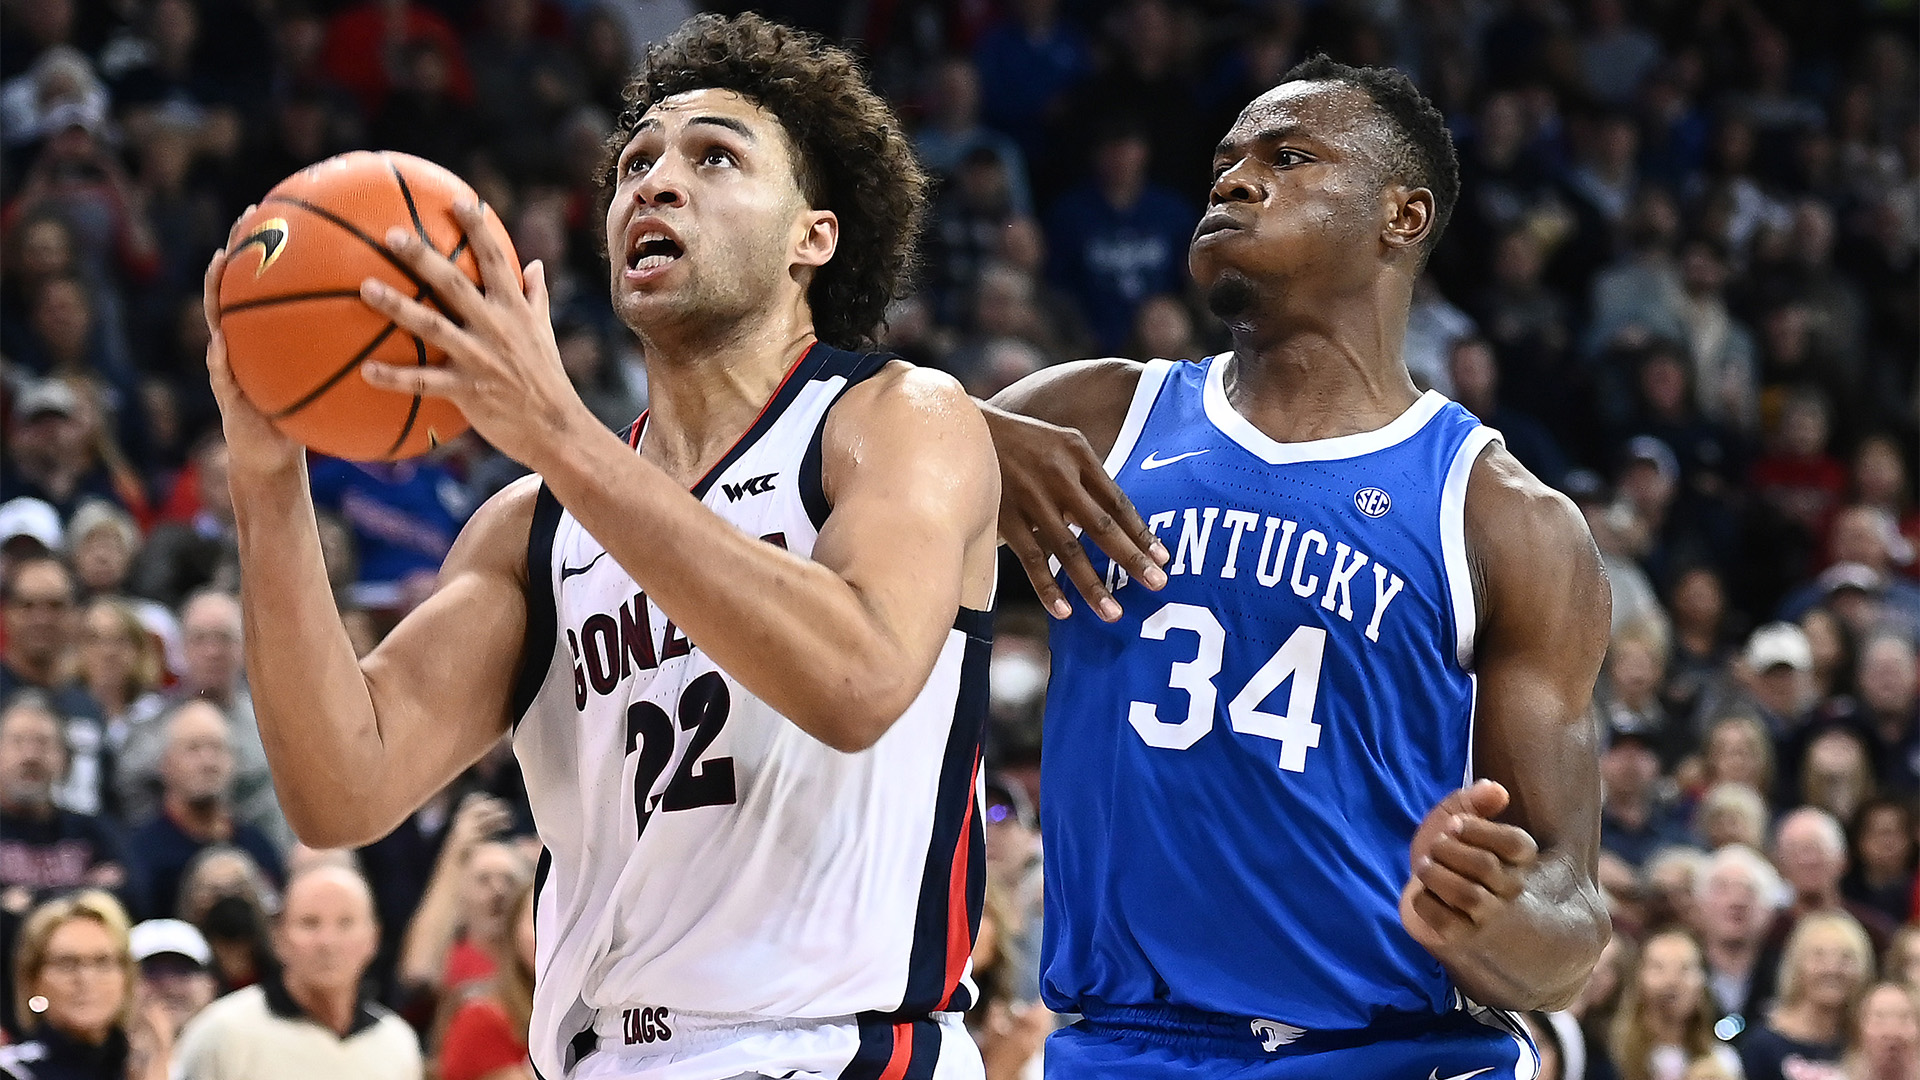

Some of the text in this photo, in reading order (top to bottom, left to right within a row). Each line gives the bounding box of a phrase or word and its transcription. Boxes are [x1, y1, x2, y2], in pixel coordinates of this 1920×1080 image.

[721, 471, 780, 503] WCC
[1357, 489, 1389, 515] SEC
[1128, 602, 1327, 773] 34
[625, 671, 737, 842] 22
[622, 1006, 672, 1045] ZAGS
